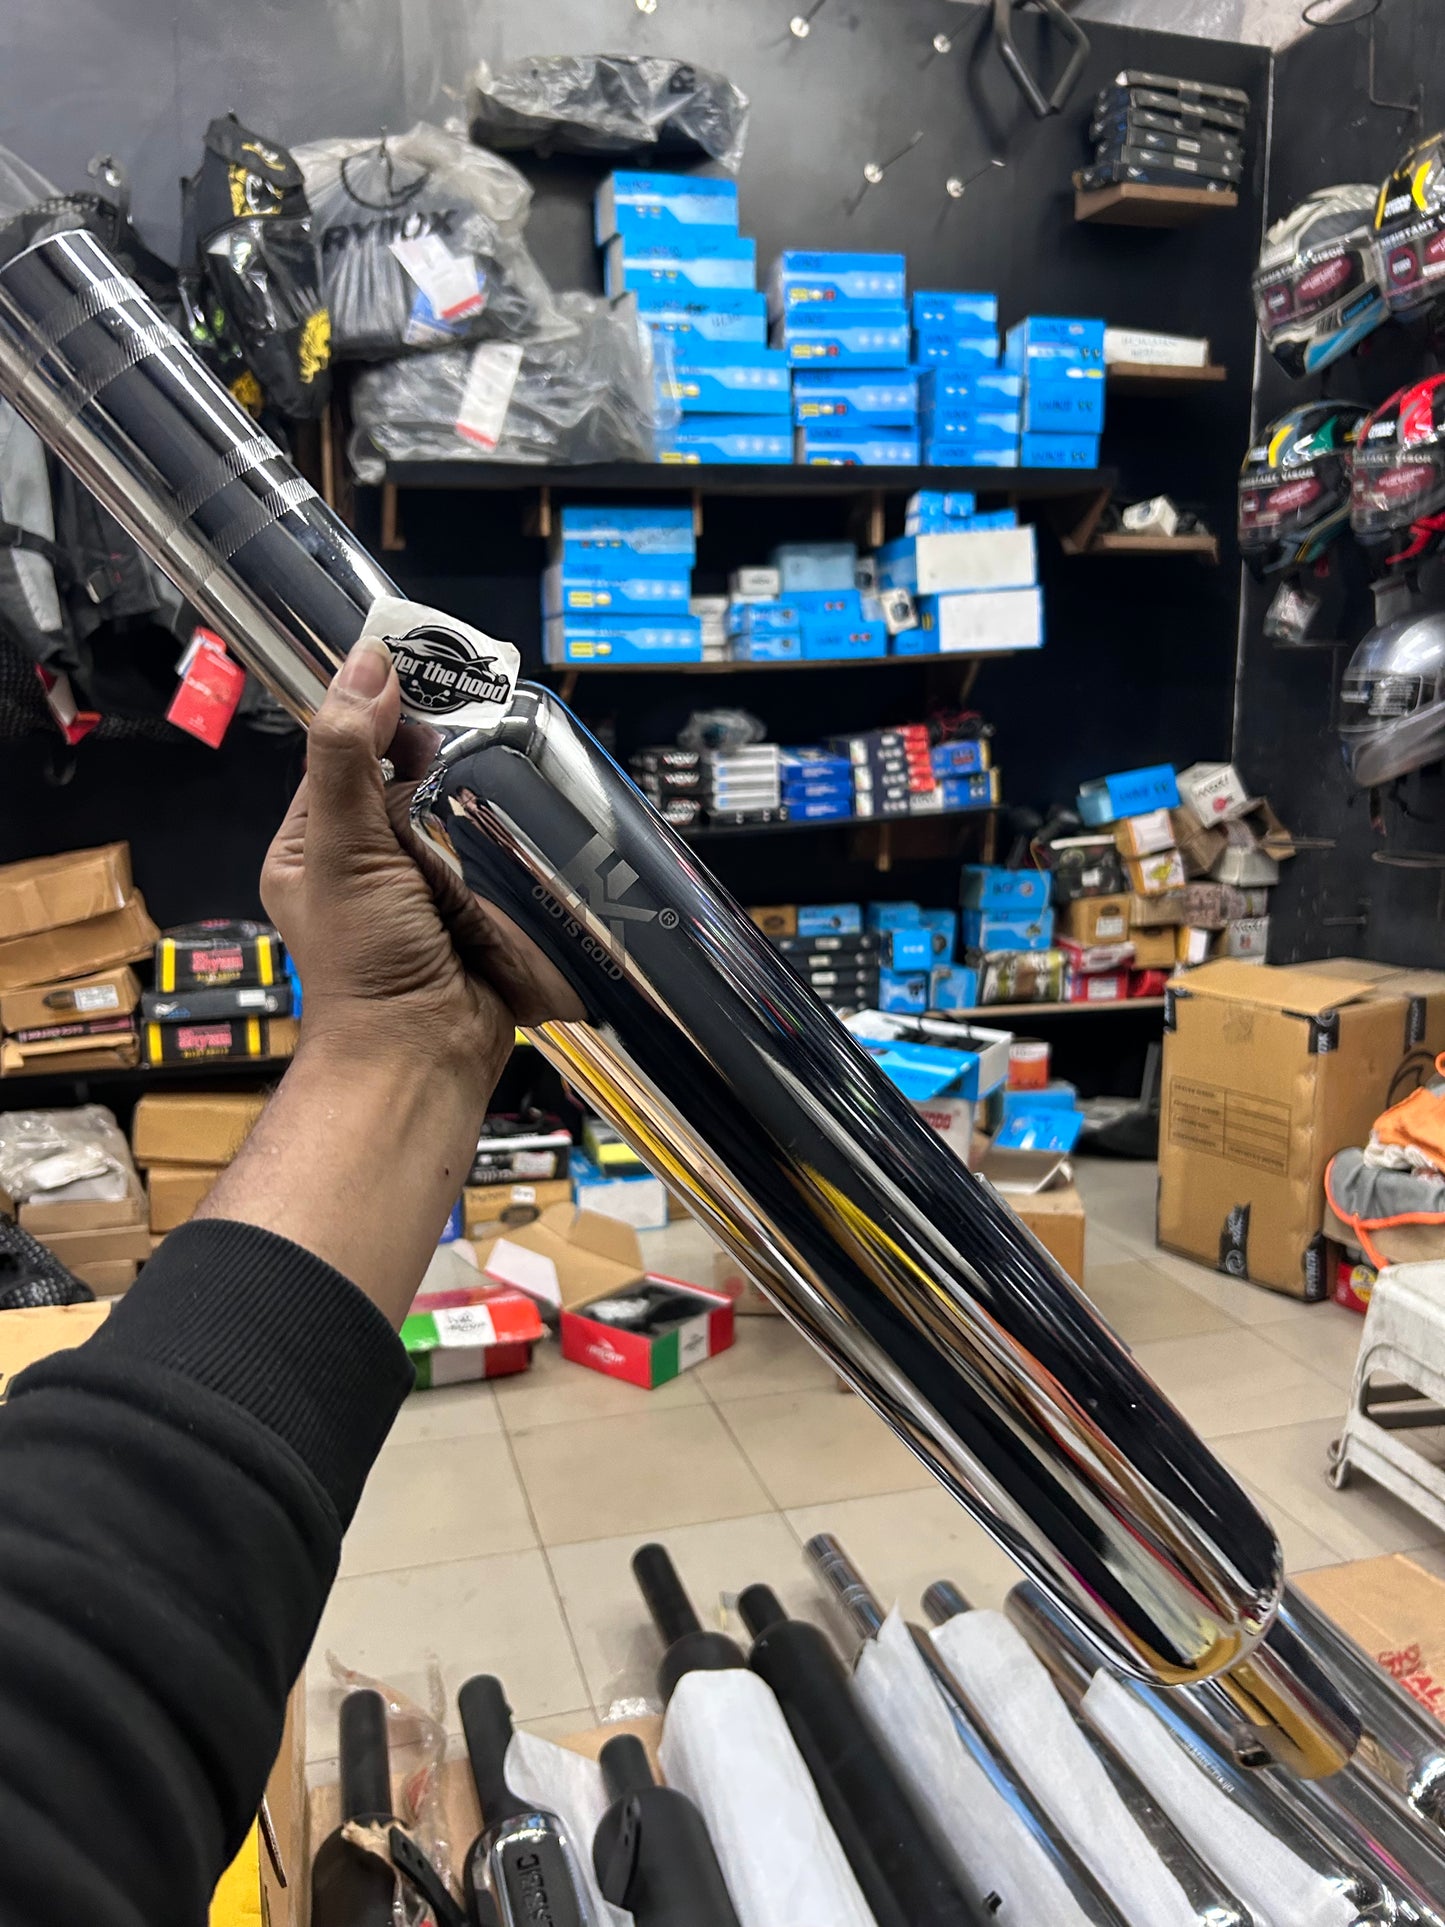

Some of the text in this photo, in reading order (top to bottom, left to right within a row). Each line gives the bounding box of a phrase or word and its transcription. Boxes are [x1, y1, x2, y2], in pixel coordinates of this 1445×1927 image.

[392, 652, 510, 702] der the hood
[531, 884, 624, 981] OLD IS GOLD
